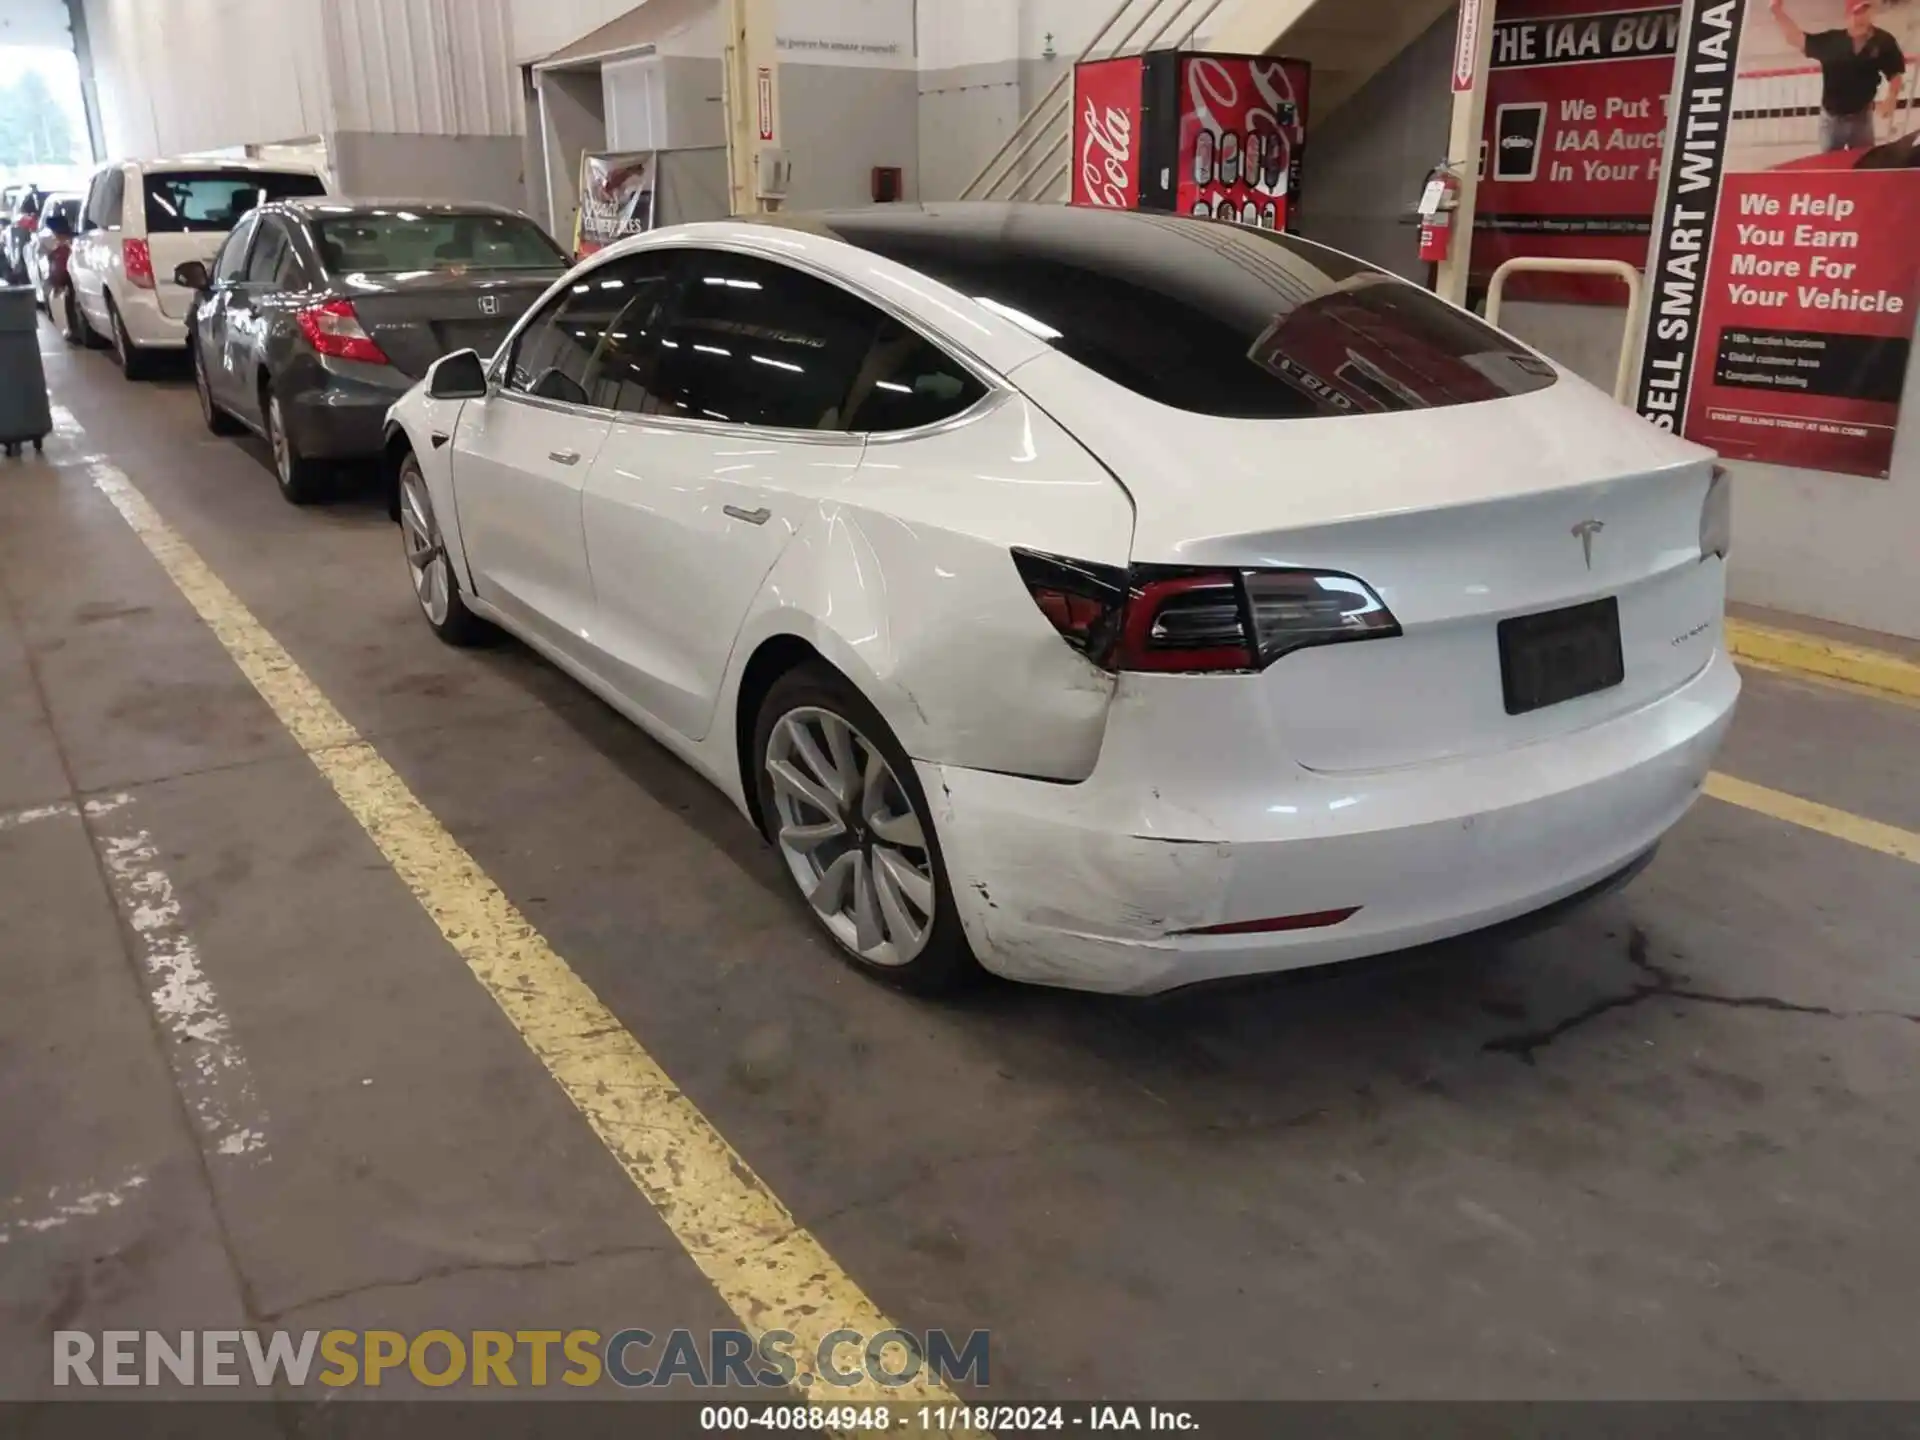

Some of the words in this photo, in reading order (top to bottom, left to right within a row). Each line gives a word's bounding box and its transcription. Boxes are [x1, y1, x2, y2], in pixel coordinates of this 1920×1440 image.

[1545, 22, 1601, 58] IAA
[1695, 0, 1736, 73] IAA
[1561, 99, 1597, 121] We
[1605, 97, 1650, 119] Put
[1555, 130, 1600, 151] IAA
[1678, 87, 1724, 194] WITH
[1550, 160, 1573, 181] In
[1583, 160, 1639, 181] Your
[1740, 193, 1780, 216] We
[1789, 193, 1855, 221] Help
[1737, 223, 1784, 246] You
[1794, 224, 1859, 248] Earn
[1657, 204, 1706, 341] SMART
[1730, 254, 1800, 277] More
[1809, 256, 1856, 279] For
[1728, 283, 1788, 307] Your
[1798, 286, 1904, 313] Vehicle
[1645, 352, 1685, 433] SELL
